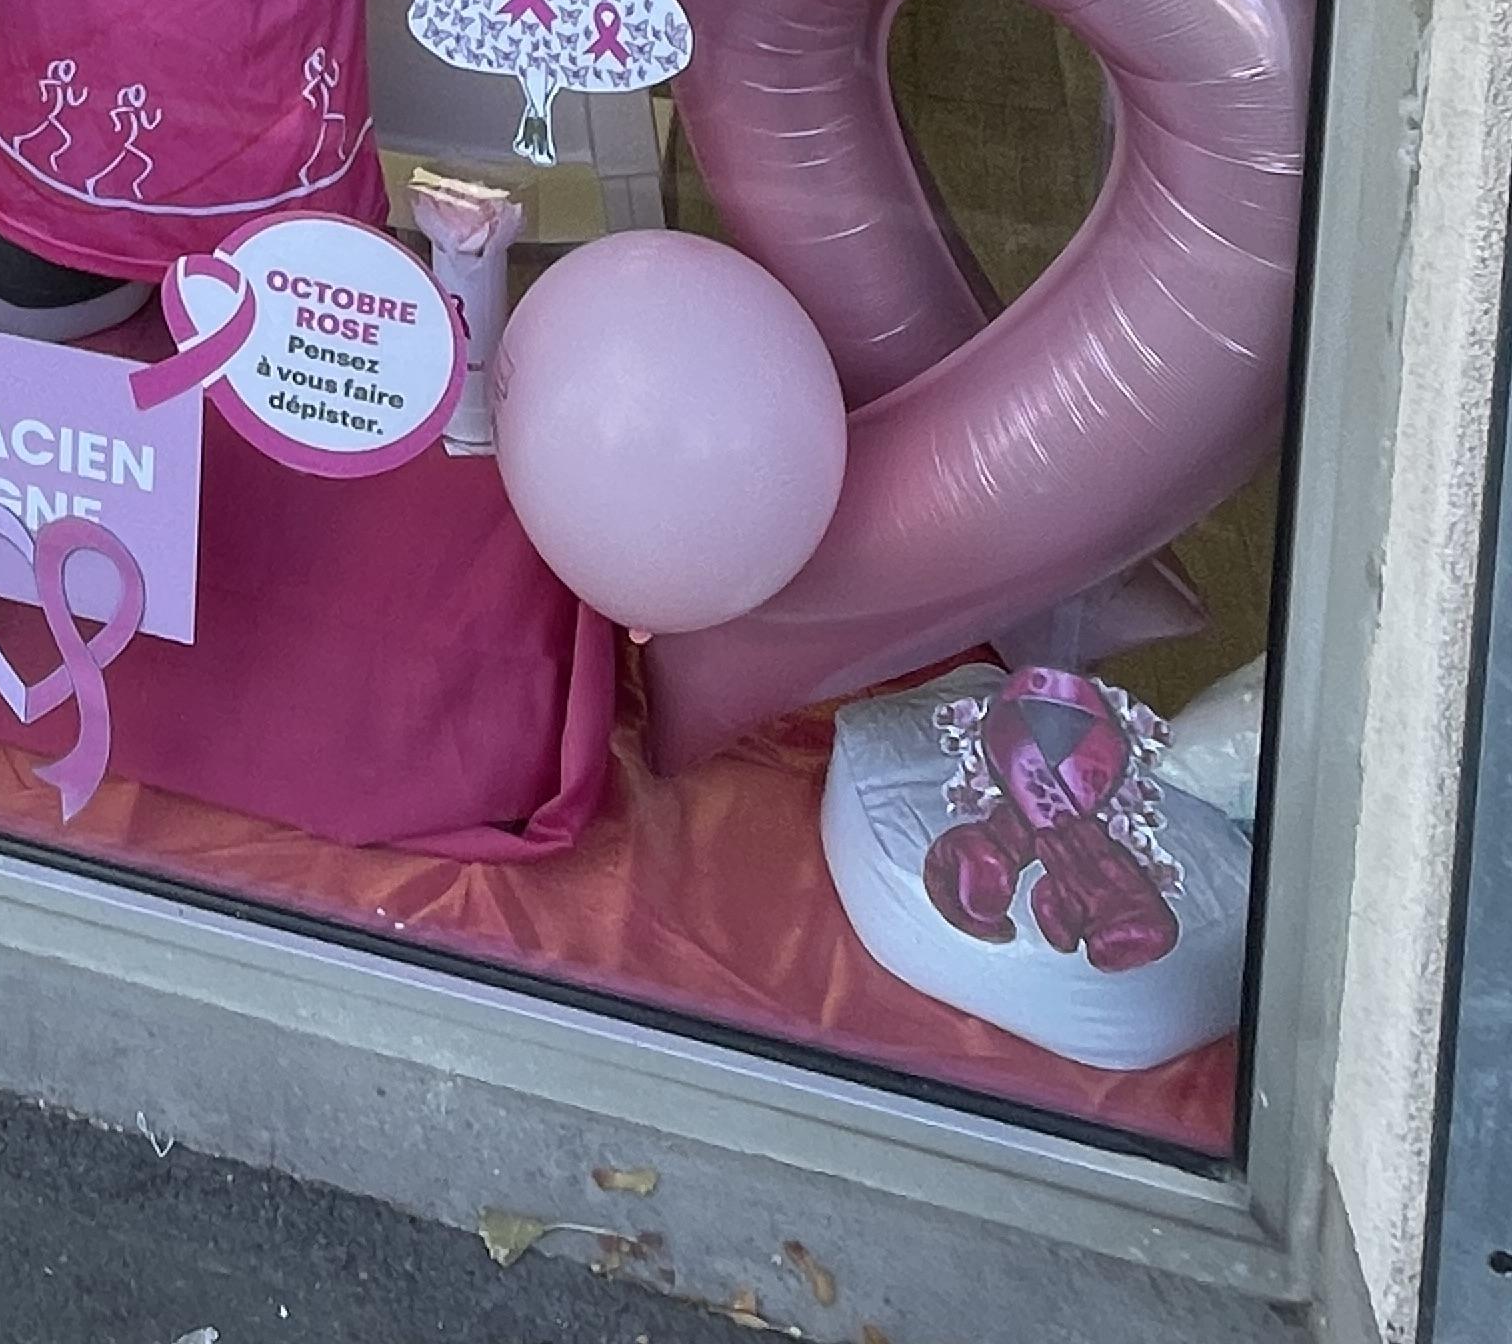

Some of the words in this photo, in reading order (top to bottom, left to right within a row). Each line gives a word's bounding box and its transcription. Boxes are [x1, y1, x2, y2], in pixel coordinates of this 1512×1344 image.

[266, 270, 418, 326] OCTOBRE
[295, 306, 380, 345] ROSE
[288, 334, 380, 374] Pensez
[256, 355, 272, 378] à
[277, 365, 338, 395] vous
[343, 377, 403, 410] faire
[268, 391, 384, 435] dépister.
